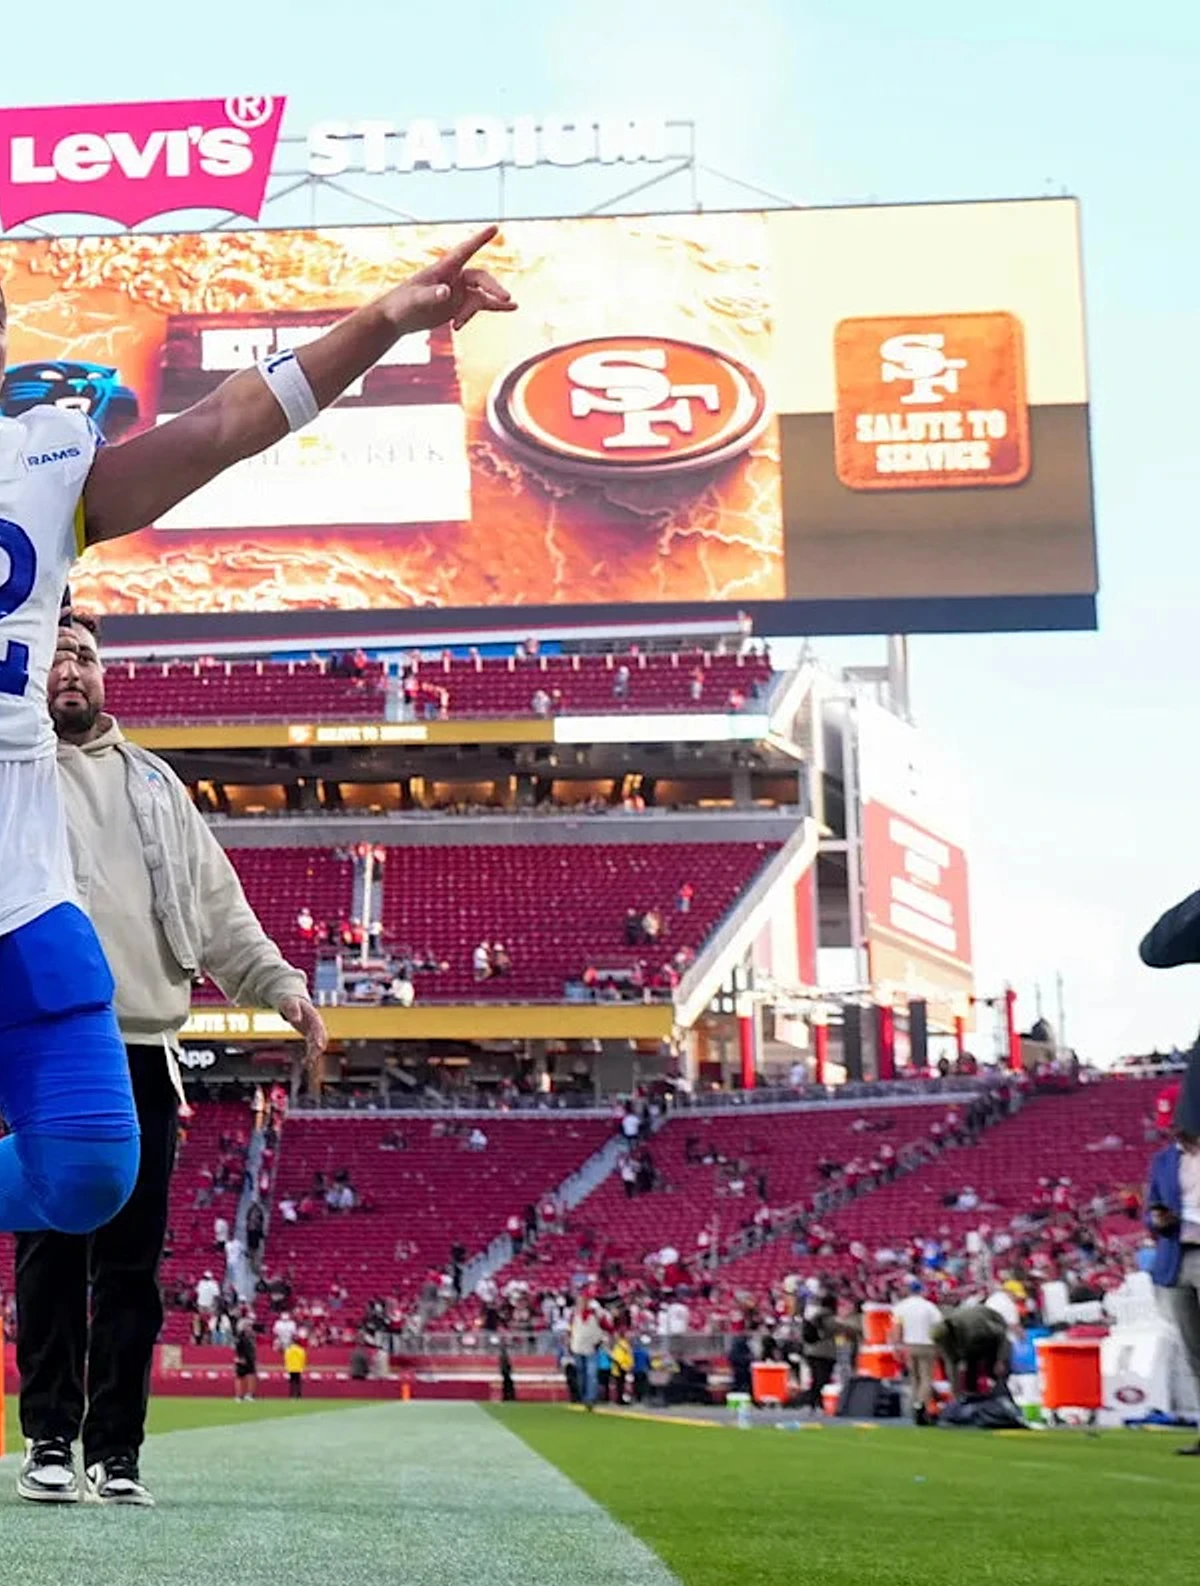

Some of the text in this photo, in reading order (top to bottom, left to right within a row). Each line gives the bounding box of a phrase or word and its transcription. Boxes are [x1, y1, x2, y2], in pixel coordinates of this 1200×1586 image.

[856, 409, 1007, 443] SALUTE TO
[27, 447, 80, 466] RAMS
